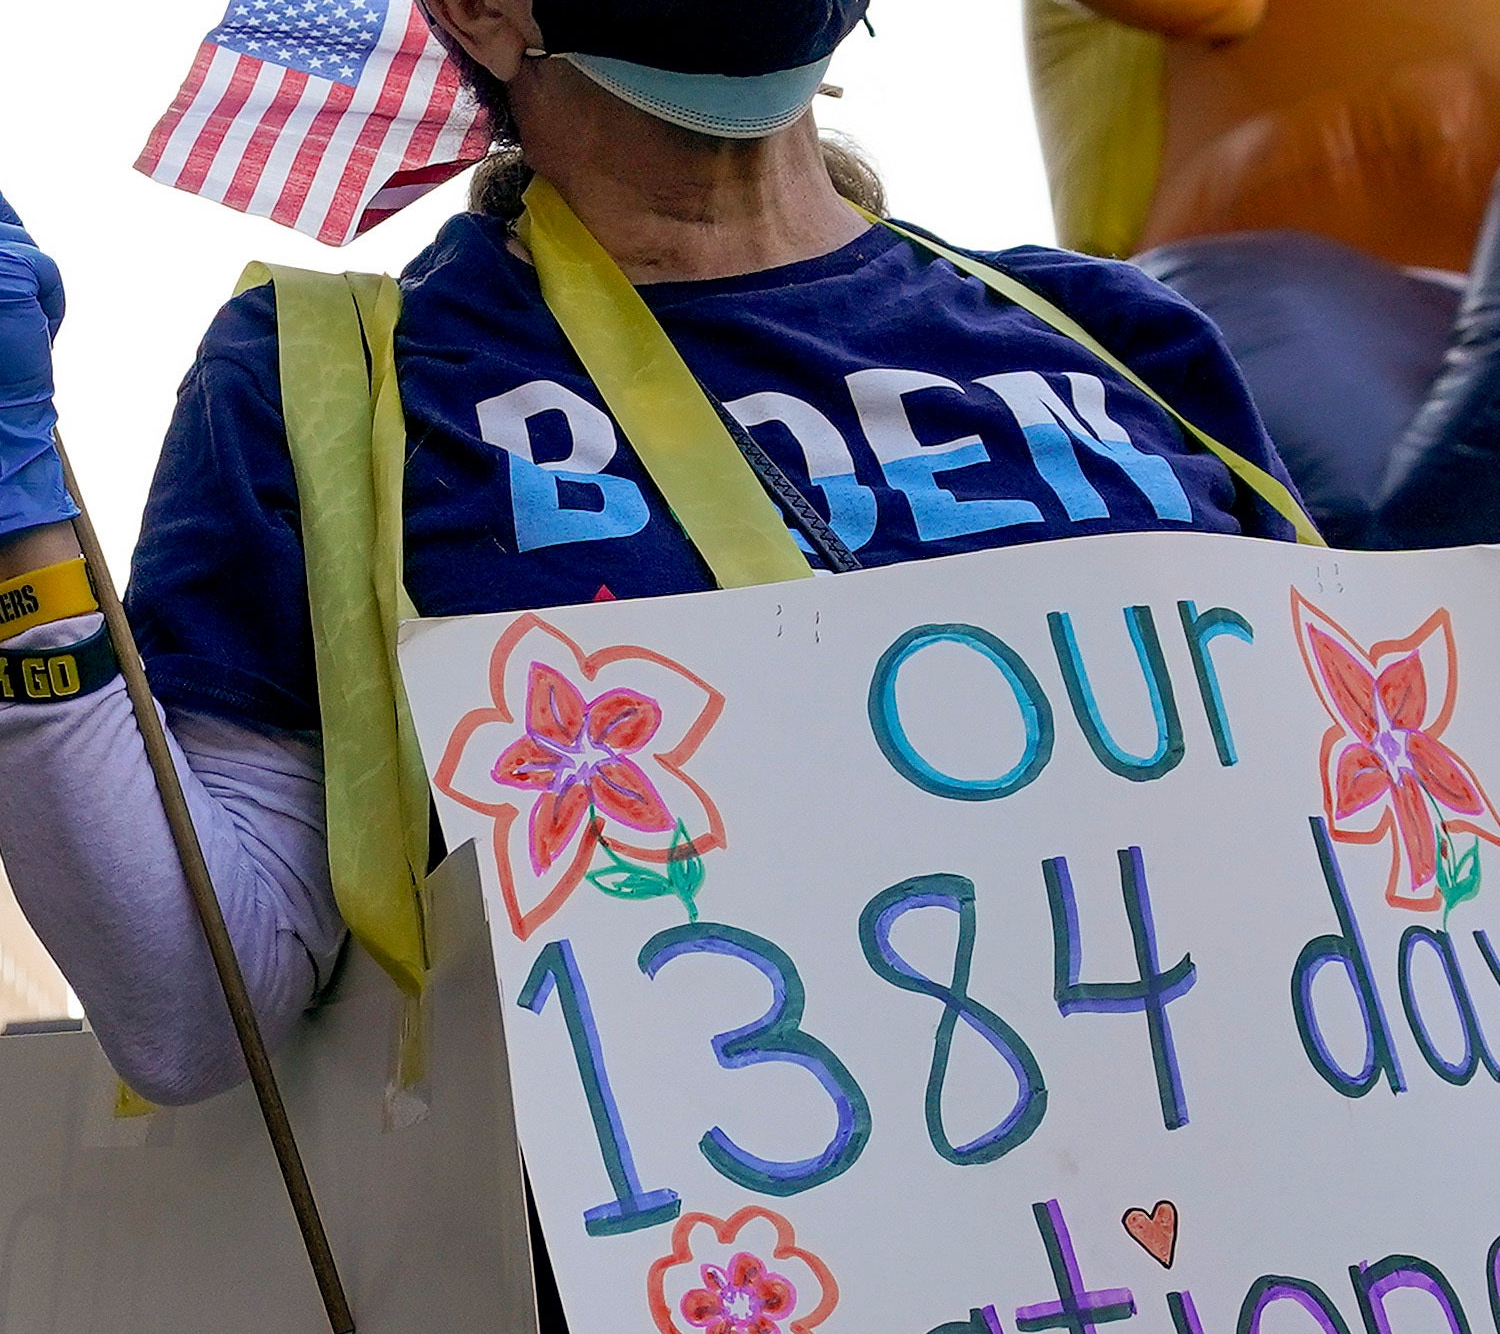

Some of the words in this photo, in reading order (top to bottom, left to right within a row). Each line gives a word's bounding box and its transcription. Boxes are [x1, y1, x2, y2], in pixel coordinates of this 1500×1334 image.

[476, 368, 1192, 555] BDEN
[22, 653, 81, 698] GO
[516, 845, 1197, 1236] 1384
